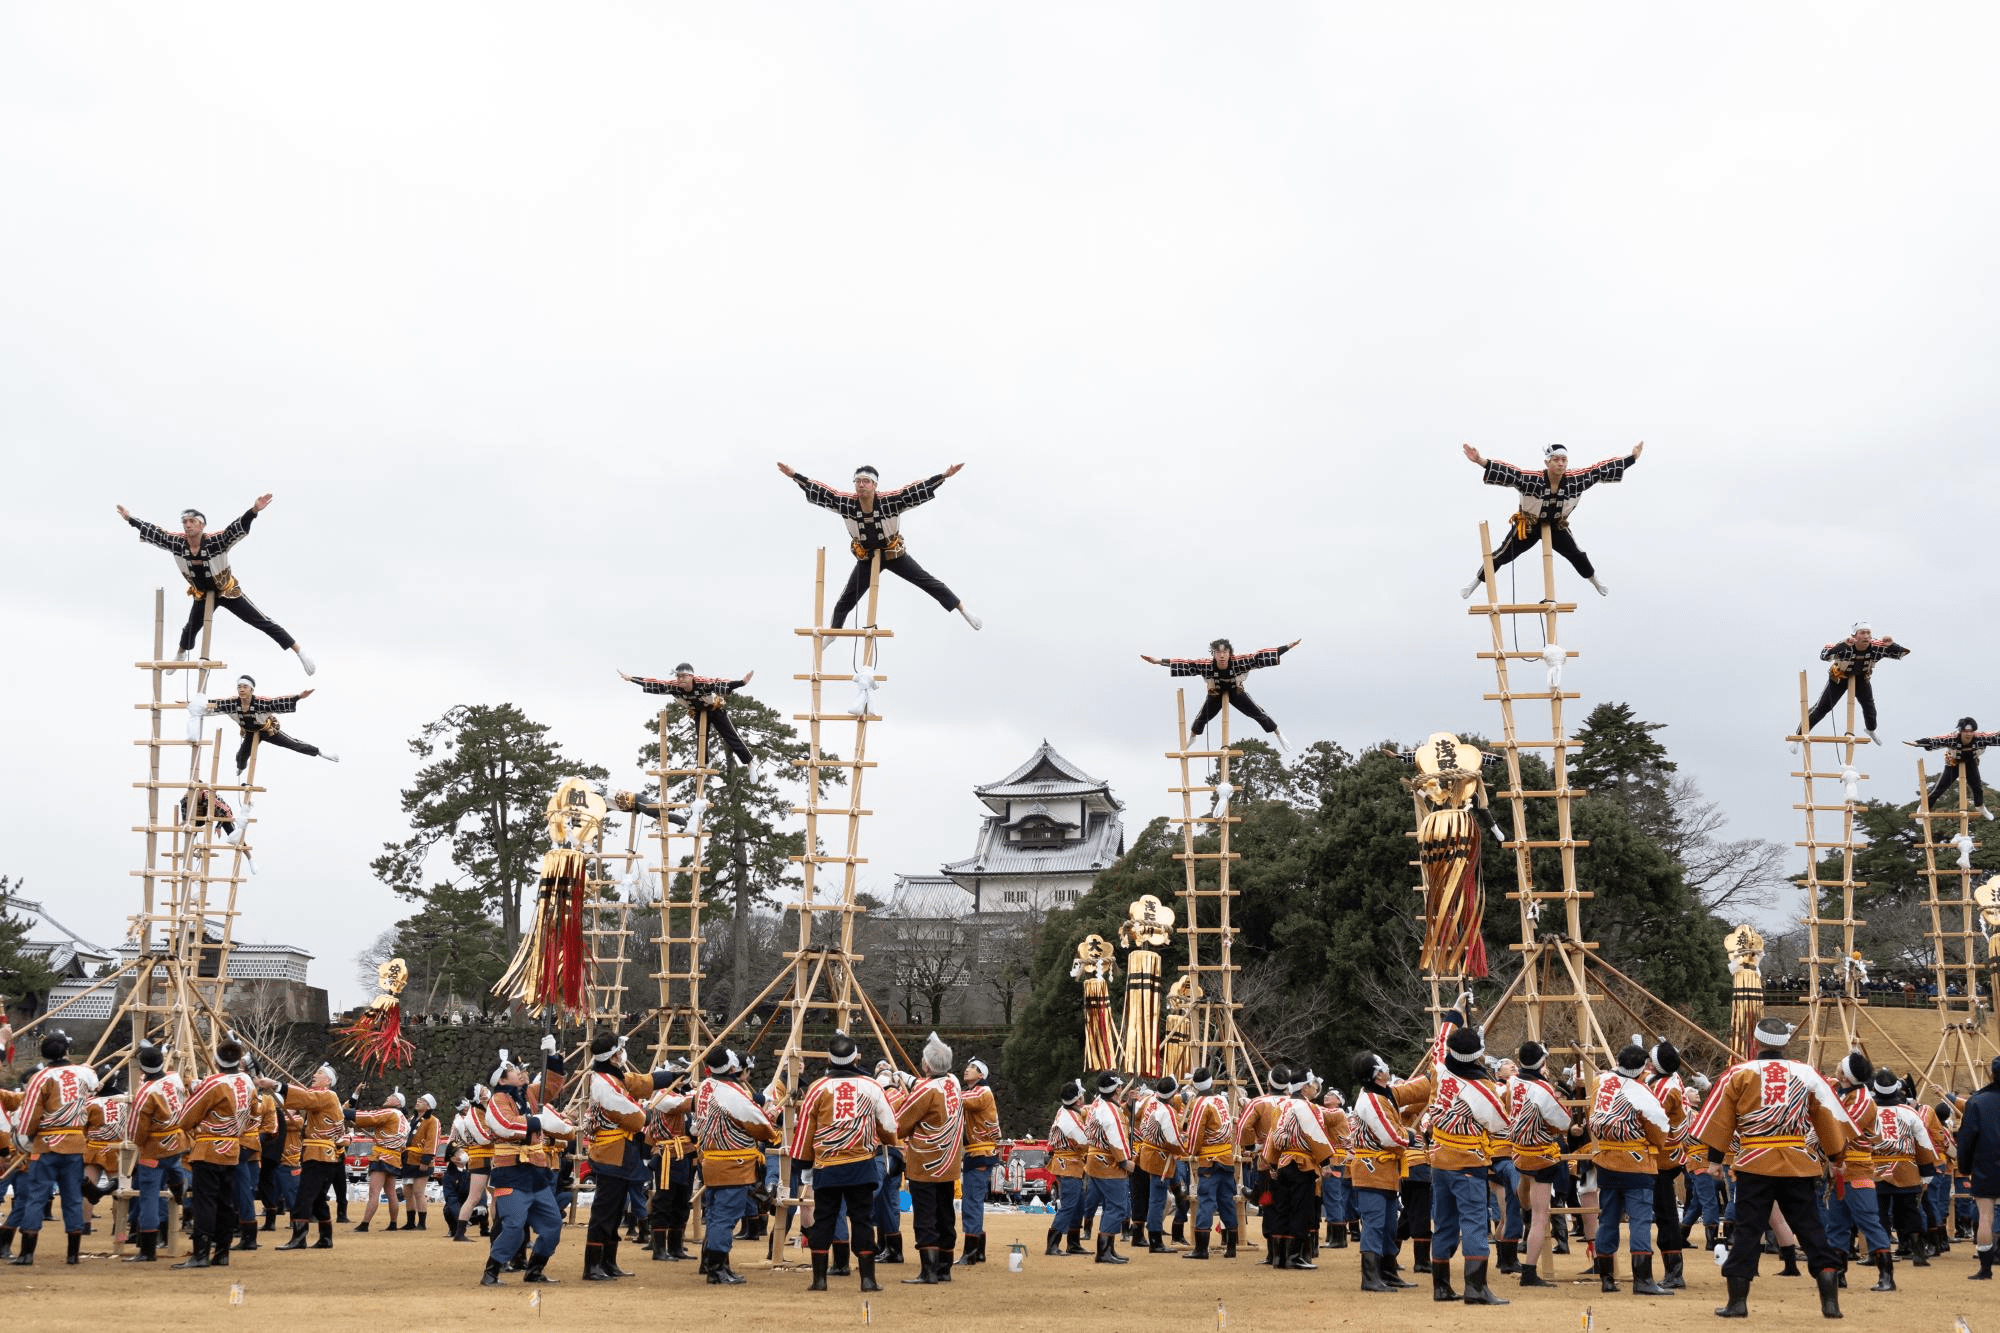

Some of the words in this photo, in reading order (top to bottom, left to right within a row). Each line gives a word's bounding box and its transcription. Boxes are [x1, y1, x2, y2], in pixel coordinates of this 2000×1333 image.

[59, 1069, 79, 1103] 金沢
[233, 1077, 248, 1111] 金沢
[698, 1082, 713, 1118] 金沢
[834, 1081, 857, 1119] 金沢
[1762, 1061, 1788, 1105] 金沢
[104, 1099, 119, 1123] 金沢
[1879, 1109, 1898, 1140] 金沢
